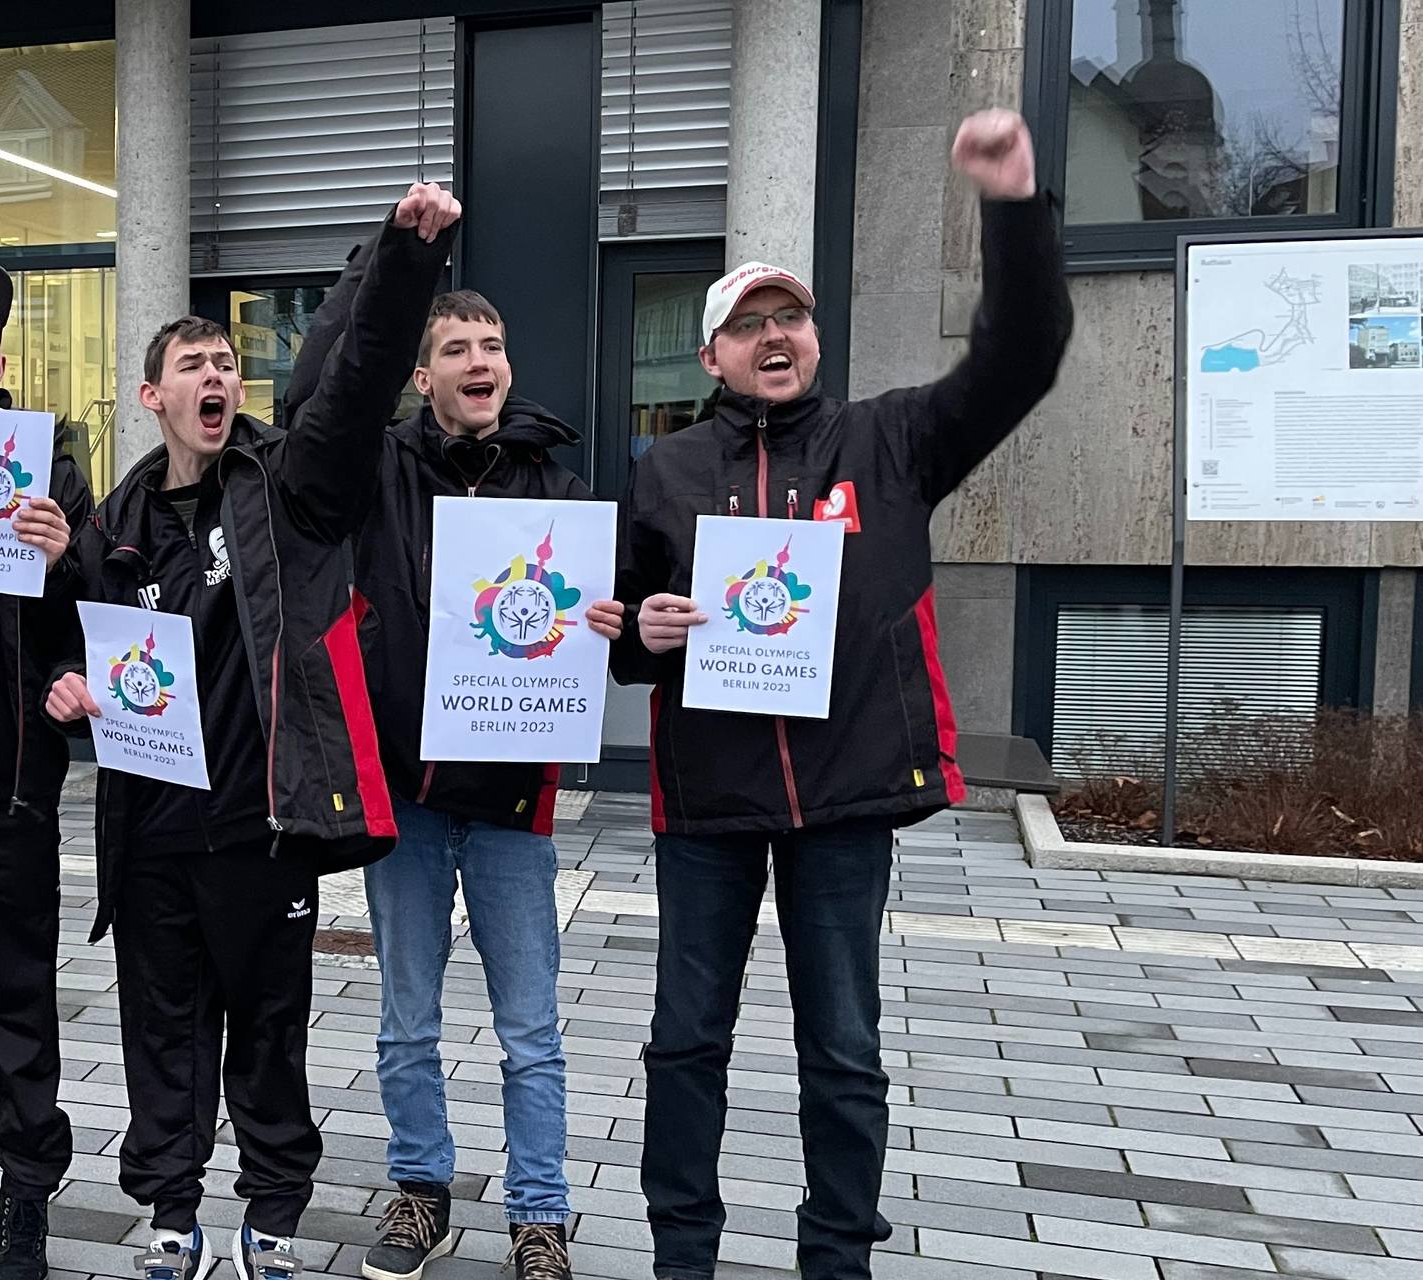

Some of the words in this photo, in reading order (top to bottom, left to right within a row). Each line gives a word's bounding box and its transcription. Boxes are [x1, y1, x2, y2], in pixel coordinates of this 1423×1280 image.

[709, 644, 751, 656] SPECIAL
[755, 648, 810, 660] OLYMPICS
[700, 659, 756, 673] WORLD
[762, 664, 817, 678] GAMES
[453, 675, 507, 687] SPECIAL
[512, 677, 579, 688] OLYMPICS
[723, 679, 759, 689] BERLIN
[763, 682, 790, 692] 2023
[441, 695, 513, 711] WORLD
[519, 698, 587, 713] GAMES
[106, 718, 138, 731] SPECIAL
[141, 726, 185, 740] OLYMPICS
[471, 721, 516, 732] BERLIN
[521, 722, 554, 733] 2023
[102, 729, 145, 746] WORLD
[149, 740, 193, 756] GAMES
[124, 748, 151, 760] BERLIN
[154, 755, 175, 765] 2023
[287, 908, 311, 918] erima
